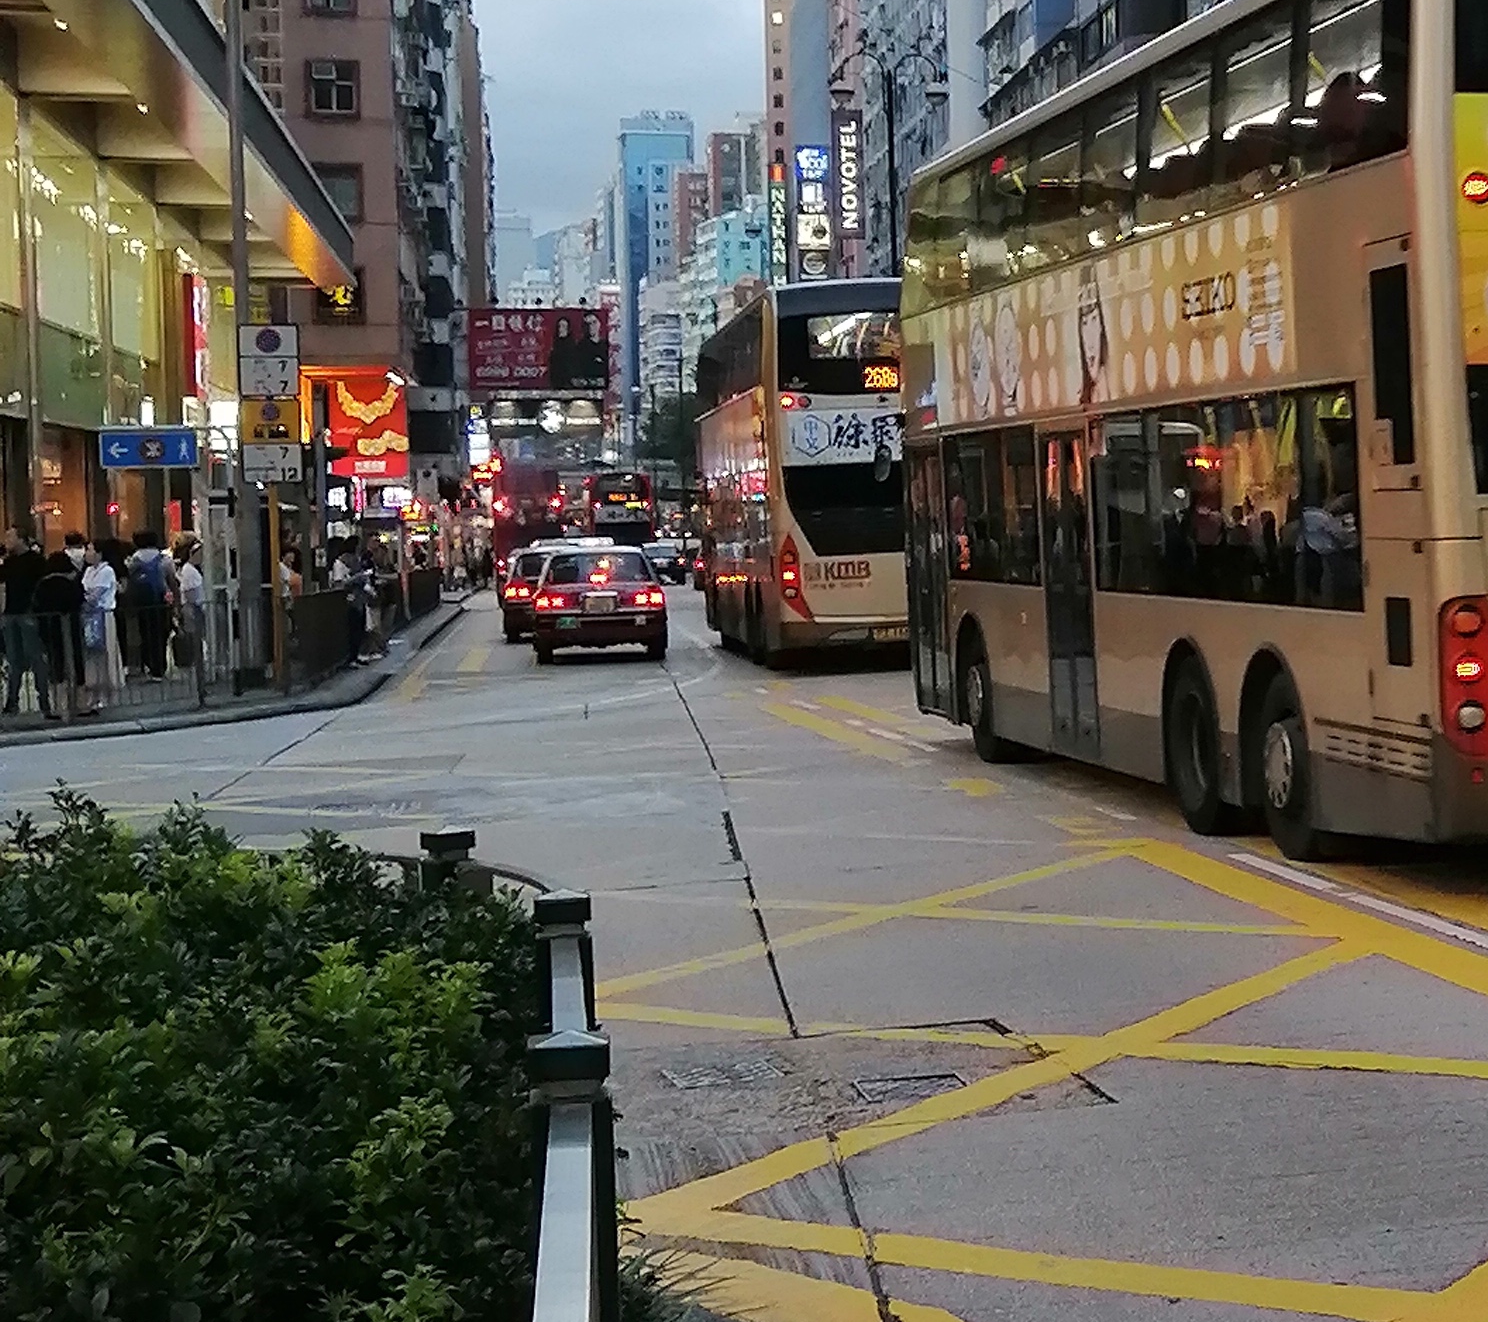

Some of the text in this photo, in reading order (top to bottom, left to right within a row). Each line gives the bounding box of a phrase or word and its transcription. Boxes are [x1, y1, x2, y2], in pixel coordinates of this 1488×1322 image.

[839, 120, 860, 230] NOVOTEL
[770, 187, 788, 265] NATHAN
[822, 560, 872, 581] KMB
